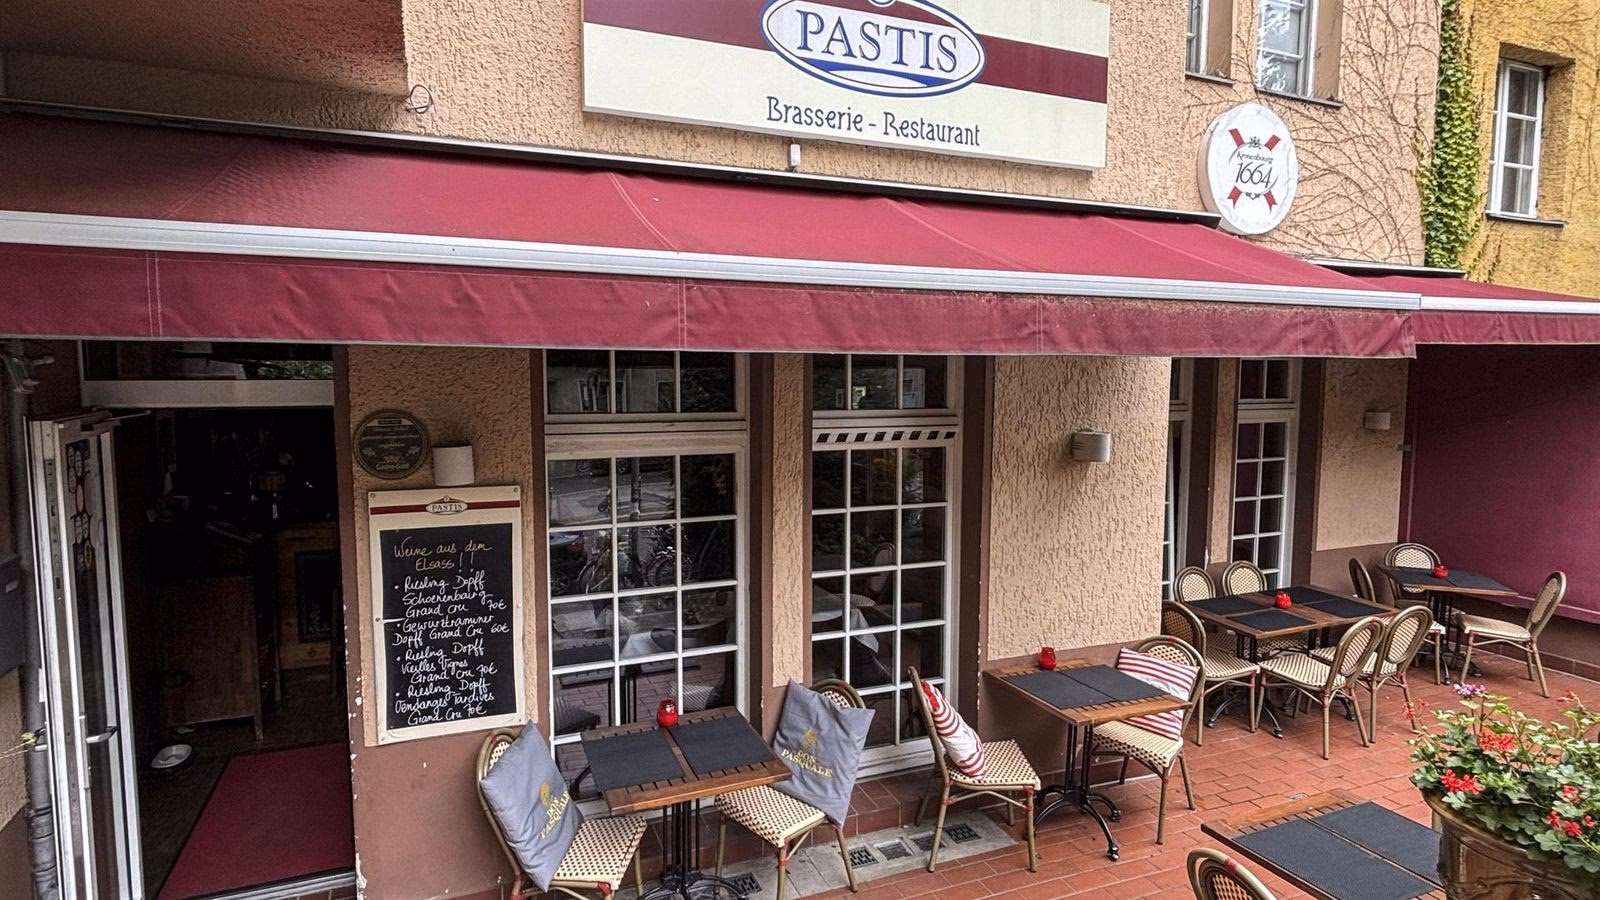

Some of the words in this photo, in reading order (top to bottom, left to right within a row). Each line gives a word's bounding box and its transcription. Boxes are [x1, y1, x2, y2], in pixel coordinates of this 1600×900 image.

[795, 9, 958, 73] PASTIS
[766, 95, 864, 133] Brasserie
[883, 111, 981, 146] Restaurant
[1235, 161, 1272, 188] 1664
[431, 502, 463, 512] PASTIS
[394, 536, 432, 557] Weine
[436, 543, 457, 554] aus
[404, 576, 449, 594] Riesling
[406, 604, 443, 618] Grand
[429, 629, 462, 640] Grand
[490, 623, 510, 633] 60€
[452, 638, 485, 657] Dopff
[410, 670, 449, 684] Grand
[407, 682, 455, 700] Riesling
[407, 709, 444, 725] Grand
[781, 749, 833, 777] PASQUALE
